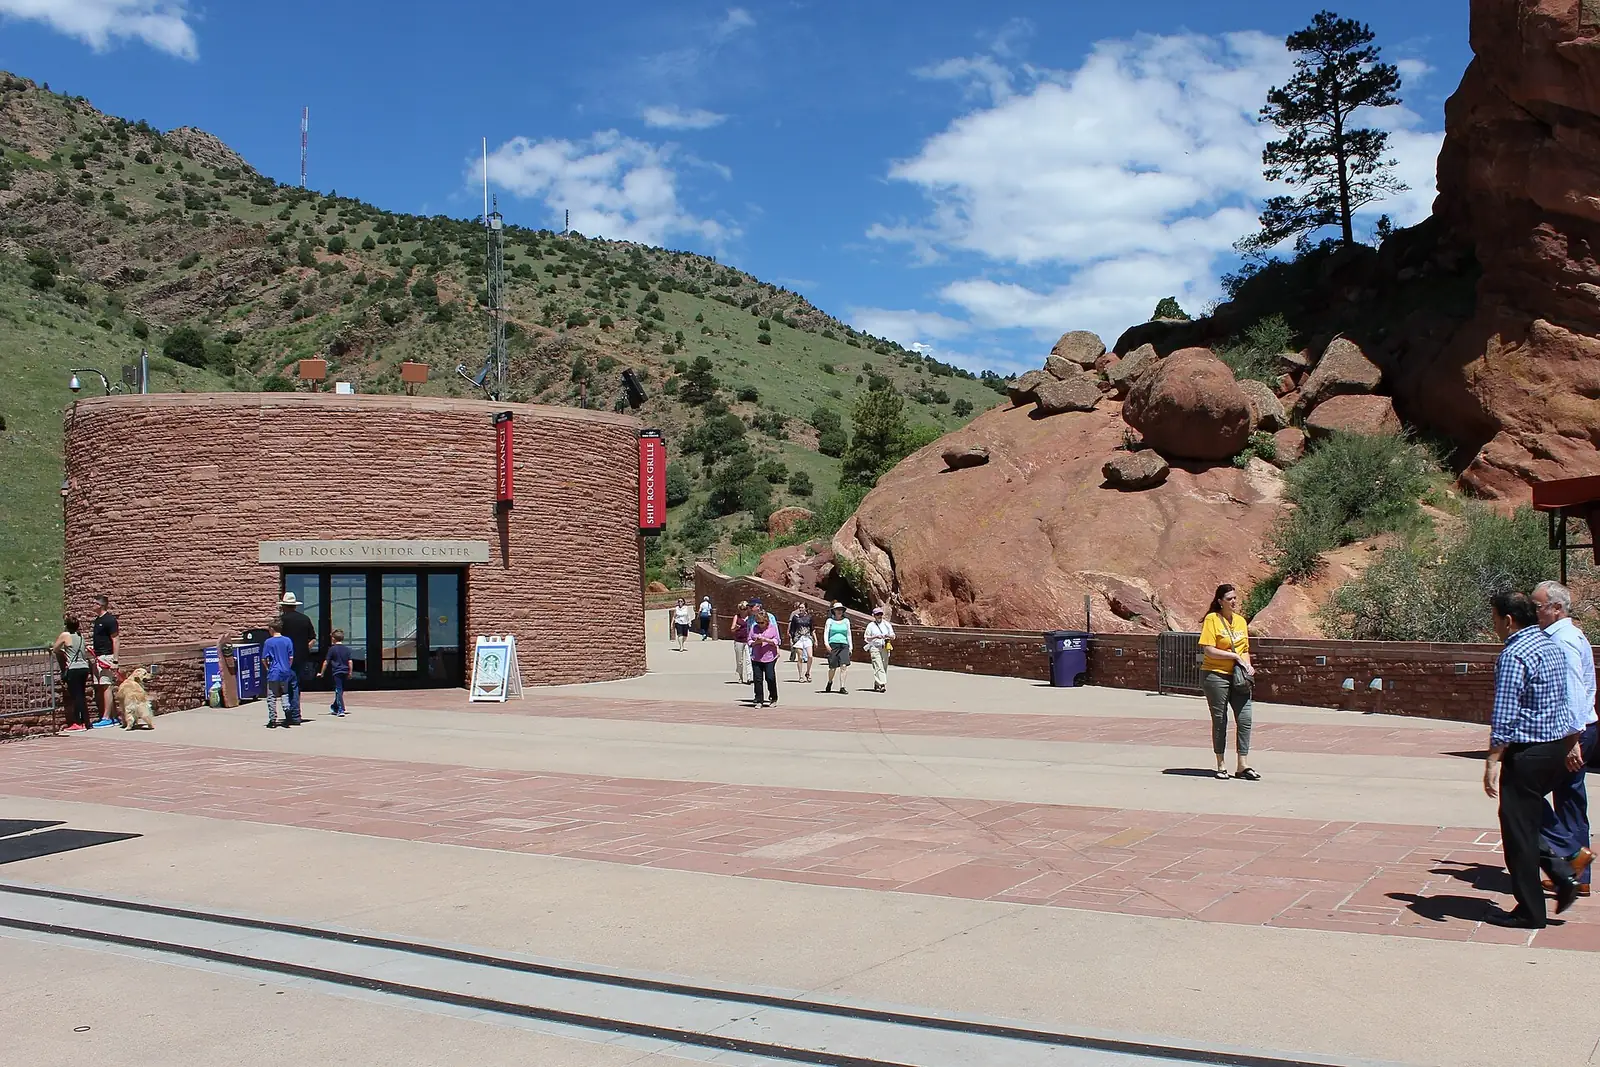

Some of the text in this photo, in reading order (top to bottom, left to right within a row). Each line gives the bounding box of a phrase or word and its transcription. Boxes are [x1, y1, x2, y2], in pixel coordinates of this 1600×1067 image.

[279, 546, 470, 556] RED ROCKS VISITOR CENTER
